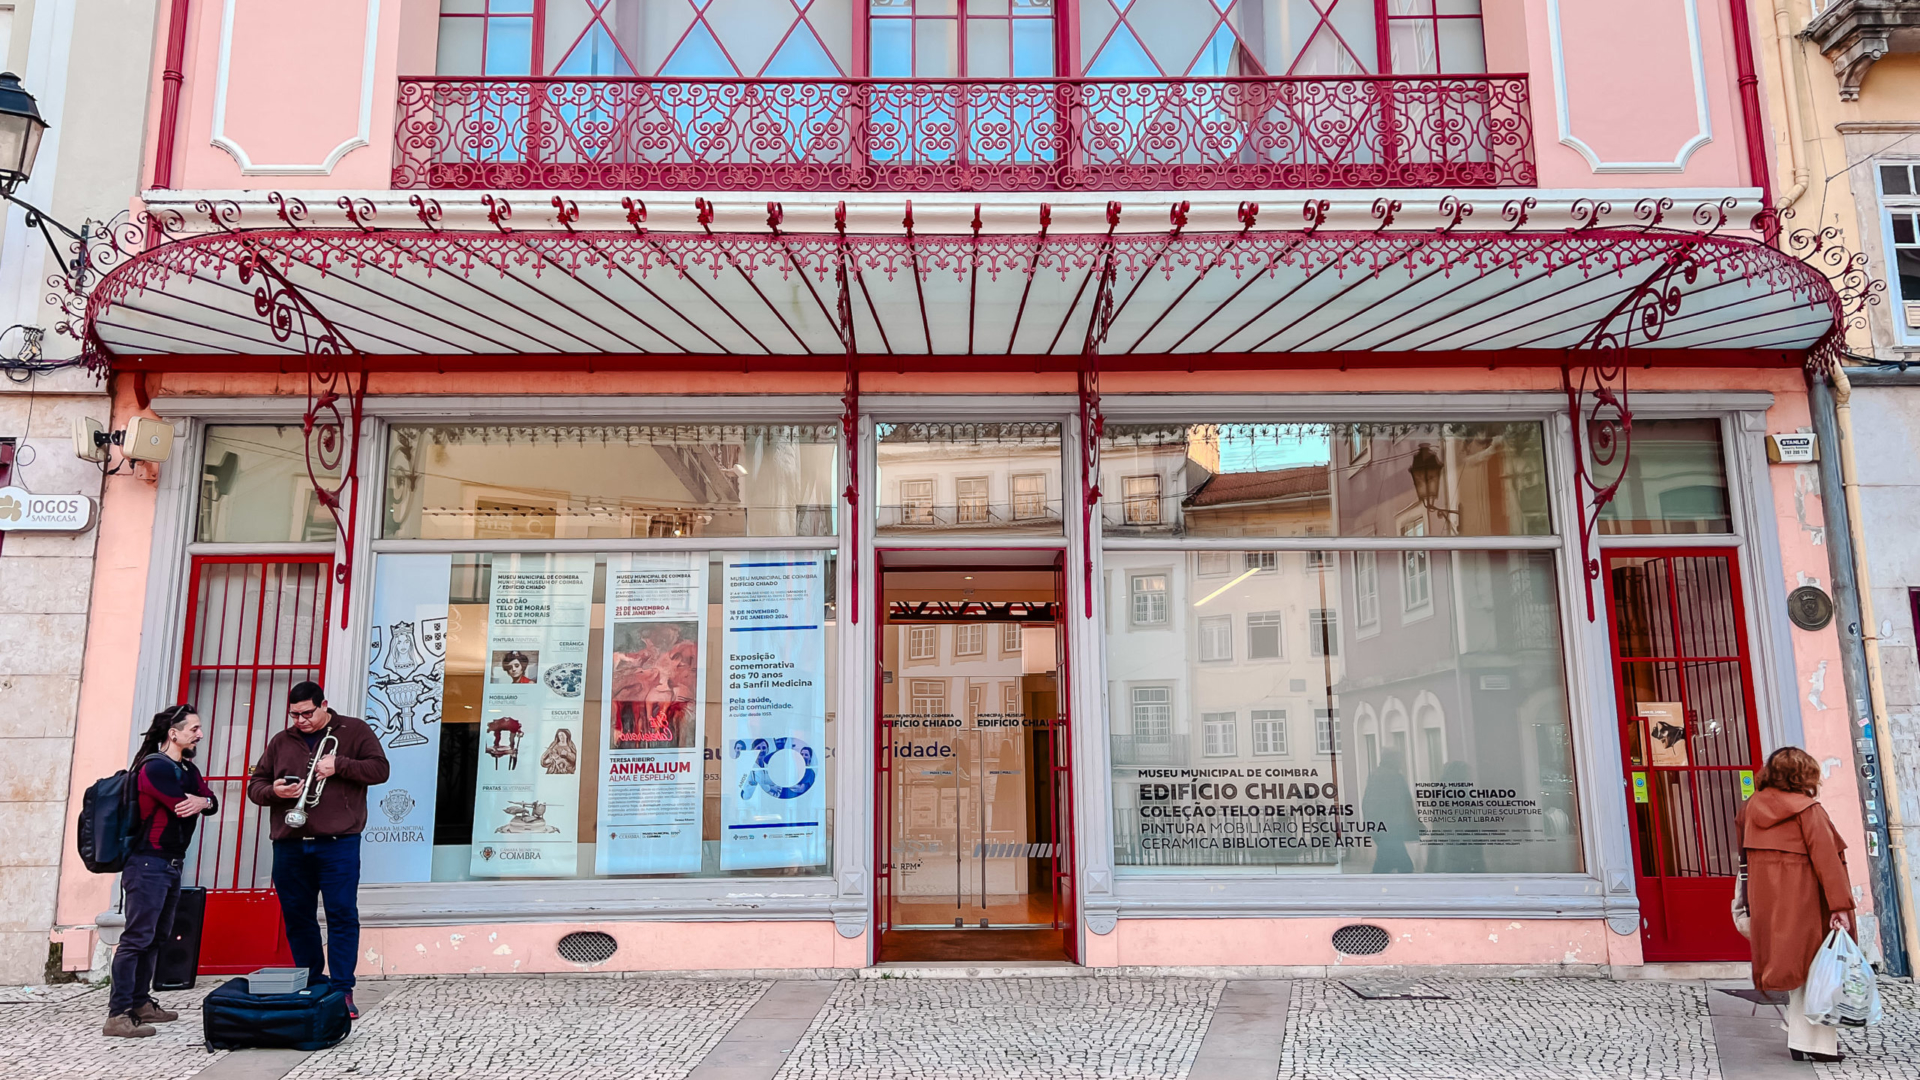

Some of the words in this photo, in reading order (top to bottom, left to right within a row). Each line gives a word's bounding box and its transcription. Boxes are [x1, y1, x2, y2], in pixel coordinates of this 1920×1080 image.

[26, 500, 78, 517] JOGOS
[730, 653, 775, 662] Exposição
[730, 661, 794, 670] comemorativa
[772, 679, 812, 687] Medicina
[978, 717, 1019, 727] EDIFÍCIO
[609, 762, 690, 774] ANIMALIUM
[1138, 770, 1178, 778] MUSEU
[1181, 769, 1244, 777] MUNICIPAL
[1265, 769, 1318, 777] COIMBRA
[1140, 778, 1238, 800] EDIFÍCIO
[1245, 783, 1338, 799] CHIADO
[1416, 786, 1466, 798] EDIFÍCIO
[1469, 790, 1516, 798] CHIADO
[1140, 802, 1216, 821] COLEÇÃO
[1220, 806, 1259, 816] TELO
[1265, 805, 1285, 816] DE
[1290, 805, 1353, 816] MORAIS
[1141, 824, 1206, 834] PINTURA
[1211, 820, 1298, 833] MOBILIÁRIO
[1302, 822, 1387, 833] ESCULTURA
[365, 832, 424, 842] COIMBRA
[1142, 838, 1219, 849] CERAMICA
[1223, 837, 1306, 849] BIBLIOTECA
[1311, 837, 1330, 847] DE
[1335, 836, 1372, 848] ARTE
